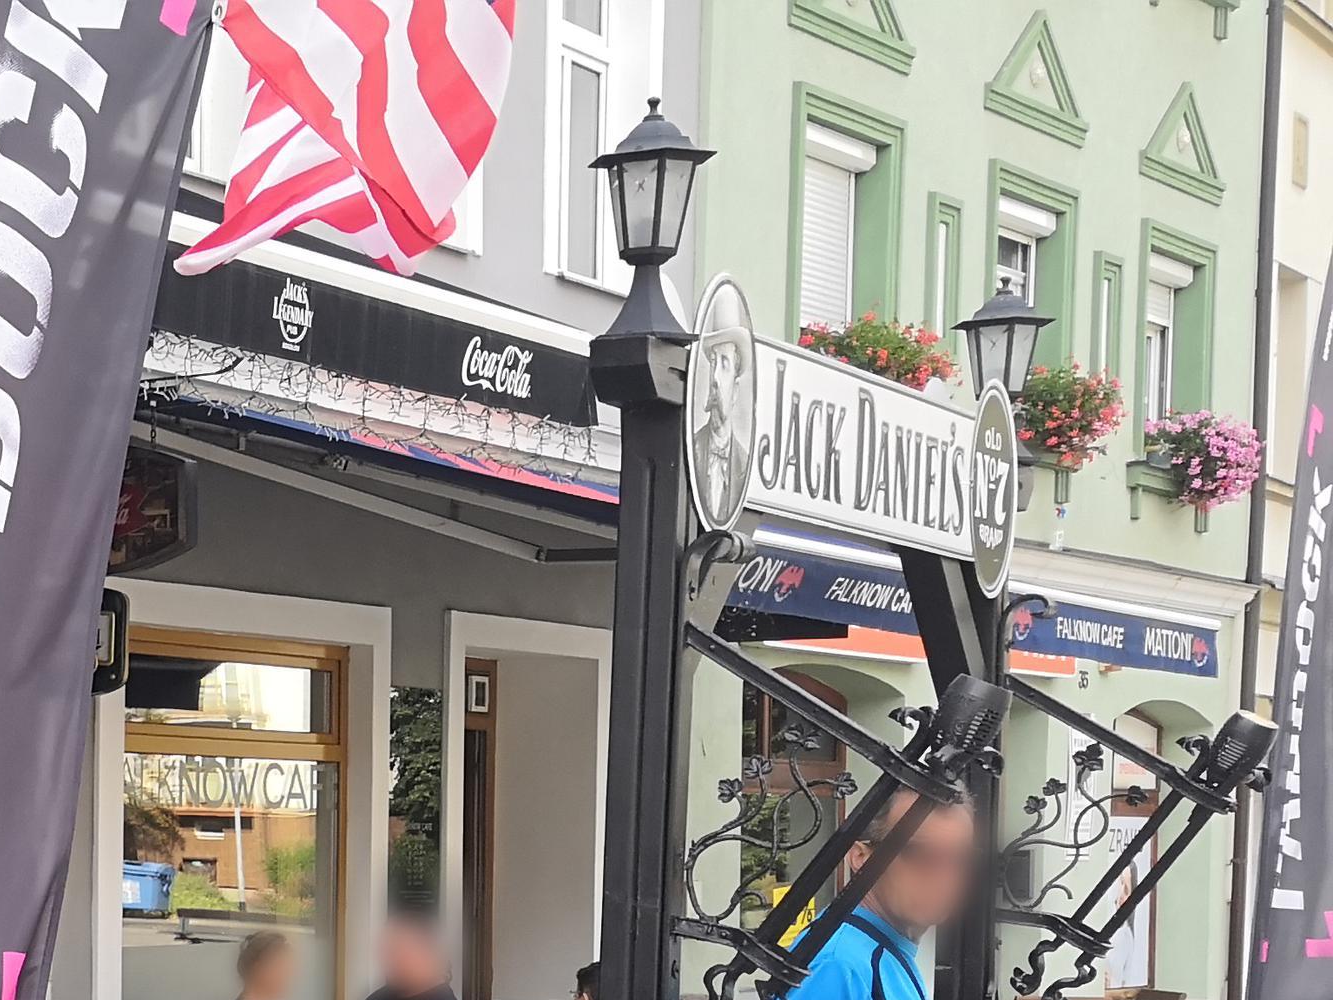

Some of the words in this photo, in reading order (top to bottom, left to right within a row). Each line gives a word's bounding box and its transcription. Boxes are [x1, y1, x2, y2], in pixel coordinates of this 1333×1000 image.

[462, 335, 533, 398] Coca-Cola
[757, 358, 847, 505] JACK
[854, 387, 966, 536] DANIEL'S
[985, 427, 1002, 451] OLD
[979, 523, 1004, 550] BRAND
[825, 577, 892, 609] FALKNOW
[1057, 617, 1100, 645] FALKNOW
[1101, 623, 1125, 649] CAFE
